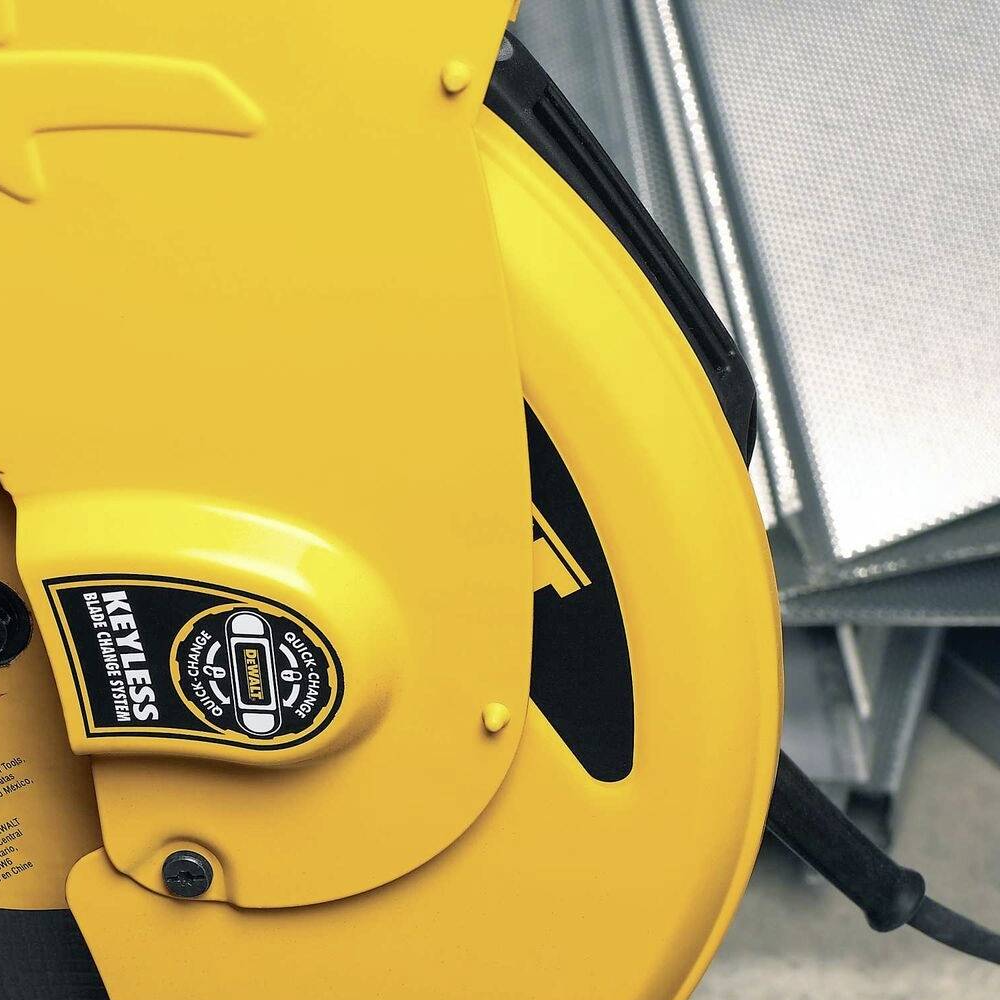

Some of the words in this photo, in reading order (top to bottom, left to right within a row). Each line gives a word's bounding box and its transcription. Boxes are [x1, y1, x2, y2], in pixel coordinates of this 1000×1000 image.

[82, 591, 101, 630] BLADE
[98, 630, 120, 677] CHANGE
[110, 676, 132, 723] SYSTEM
[101, 590, 159, 722] KEYLESS
[187, 629, 223, 718] QUICK-CHANGE
[284, 631, 322, 720] QUICK-CHANGE
[1, 869, 12, 879] en
[10, 859, 34, 874] Chine
